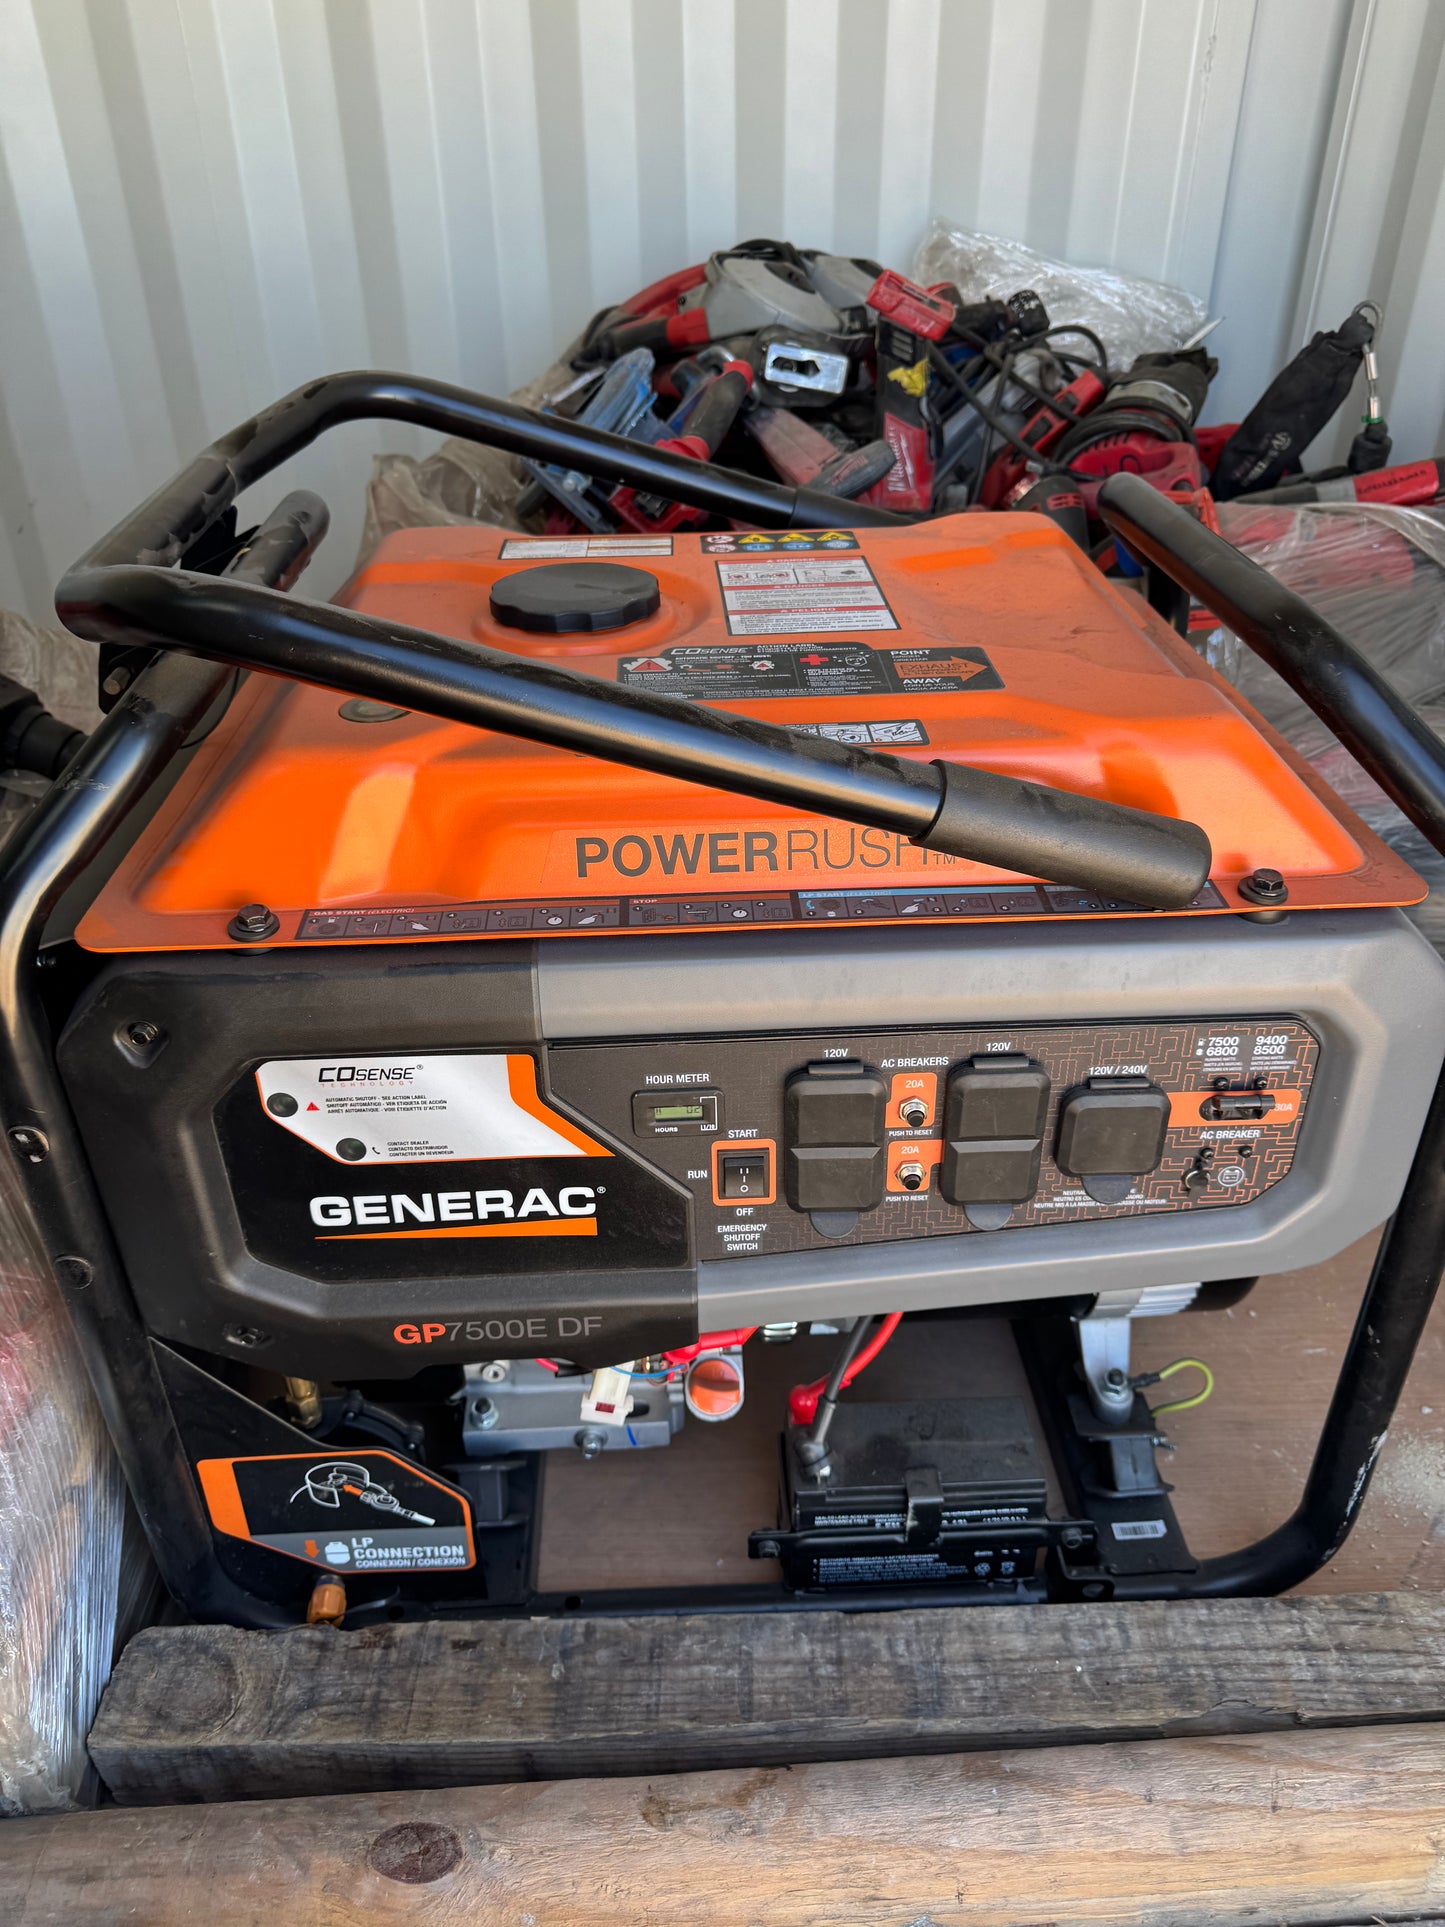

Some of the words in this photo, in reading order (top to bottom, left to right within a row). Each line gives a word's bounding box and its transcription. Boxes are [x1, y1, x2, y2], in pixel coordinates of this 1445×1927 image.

[1208, 1036, 1239, 1046] 7500
[1256, 1035, 1288, 1045] 9400
[986, 1042, 1012, 1052] 120V
[1206, 1047, 1238, 1056] 6800
[1253, 1045, 1285, 1055] 8500
[824, 1049, 848, 1058] 120V
[881, 1059, 895, 1067] AC
[898, 1057, 949, 1067] BREAKERS
[1089, 1066, 1113, 1075] 120V
[1122, 1065, 1147, 1074] 240V
[646, 1075, 673, 1084] HOUR
[676, 1074, 710, 1083] METER
[905, 1080, 924, 1088] 20A
[728, 1129, 758, 1138] START
[1200, 1131, 1214, 1139] AC
[1216, 1130, 1260, 1139] BREAKER
[901, 1146, 919, 1154] 20A
[688, 1170, 707, 1179] RUN
[736, 1208, 753, 1216] OFF
[717, 1224, 767, 1233] EMERGENCY
[393, 1318, 547, 1344] GP7500E
[558, 1316, 603, 1337] DF
[351, 1537, 373, 1548] LP
[354, 1545, 464, 1560] CONNECTION
[356, 1559, 411, 1568] CONNEXION
